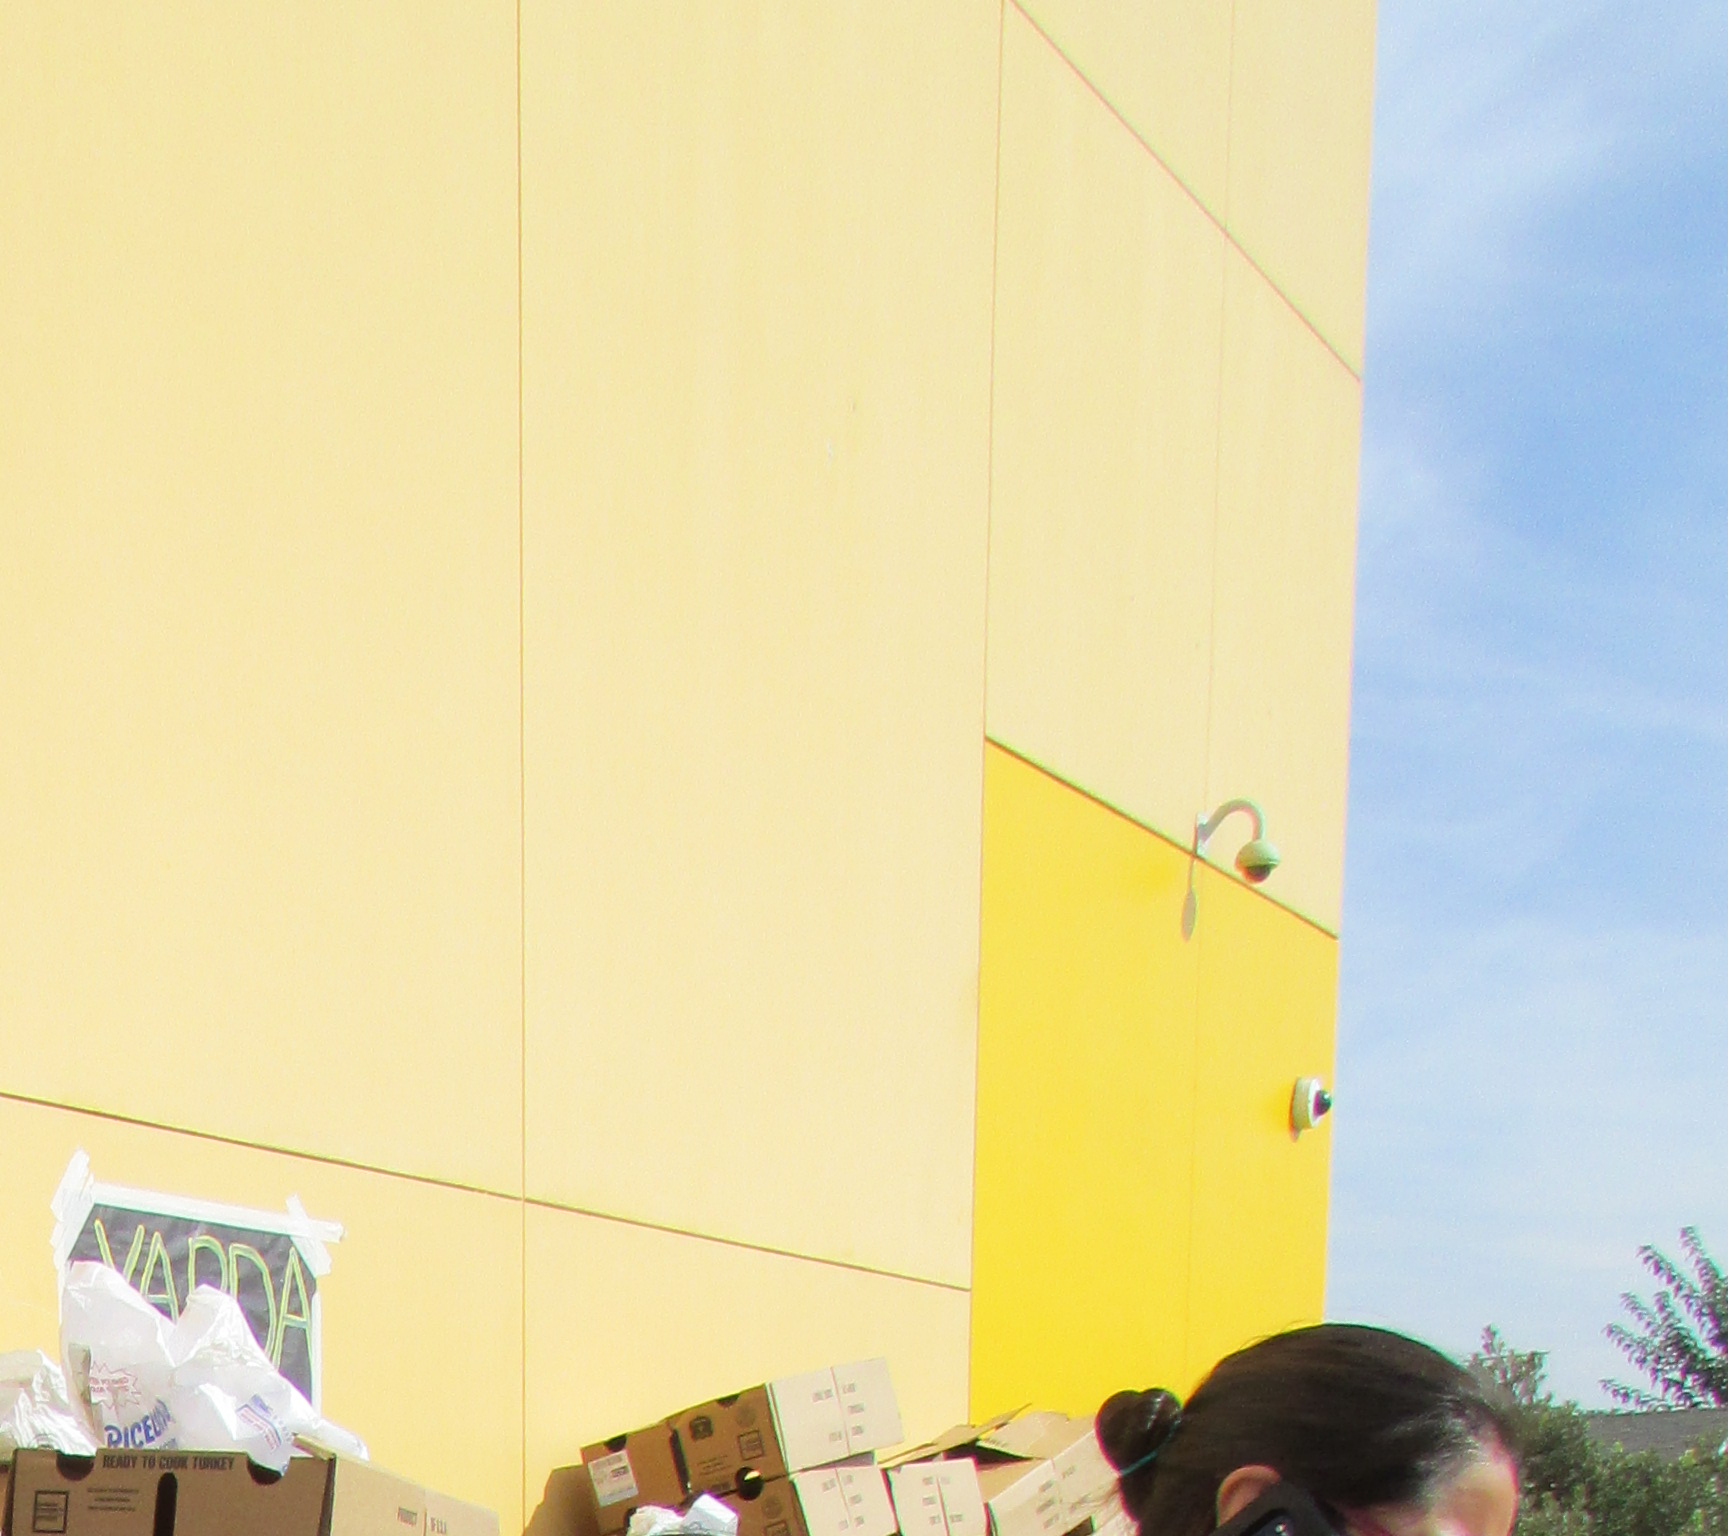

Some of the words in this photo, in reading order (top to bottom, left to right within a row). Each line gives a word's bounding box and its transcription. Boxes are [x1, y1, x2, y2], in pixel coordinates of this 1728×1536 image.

[103, 1455, 137, 1470] READY
[143, 1456, 155, 1470] TO
[159, 1456, 188, 1471] COOK
[193, 1457, 235, 1472] TURKEY
